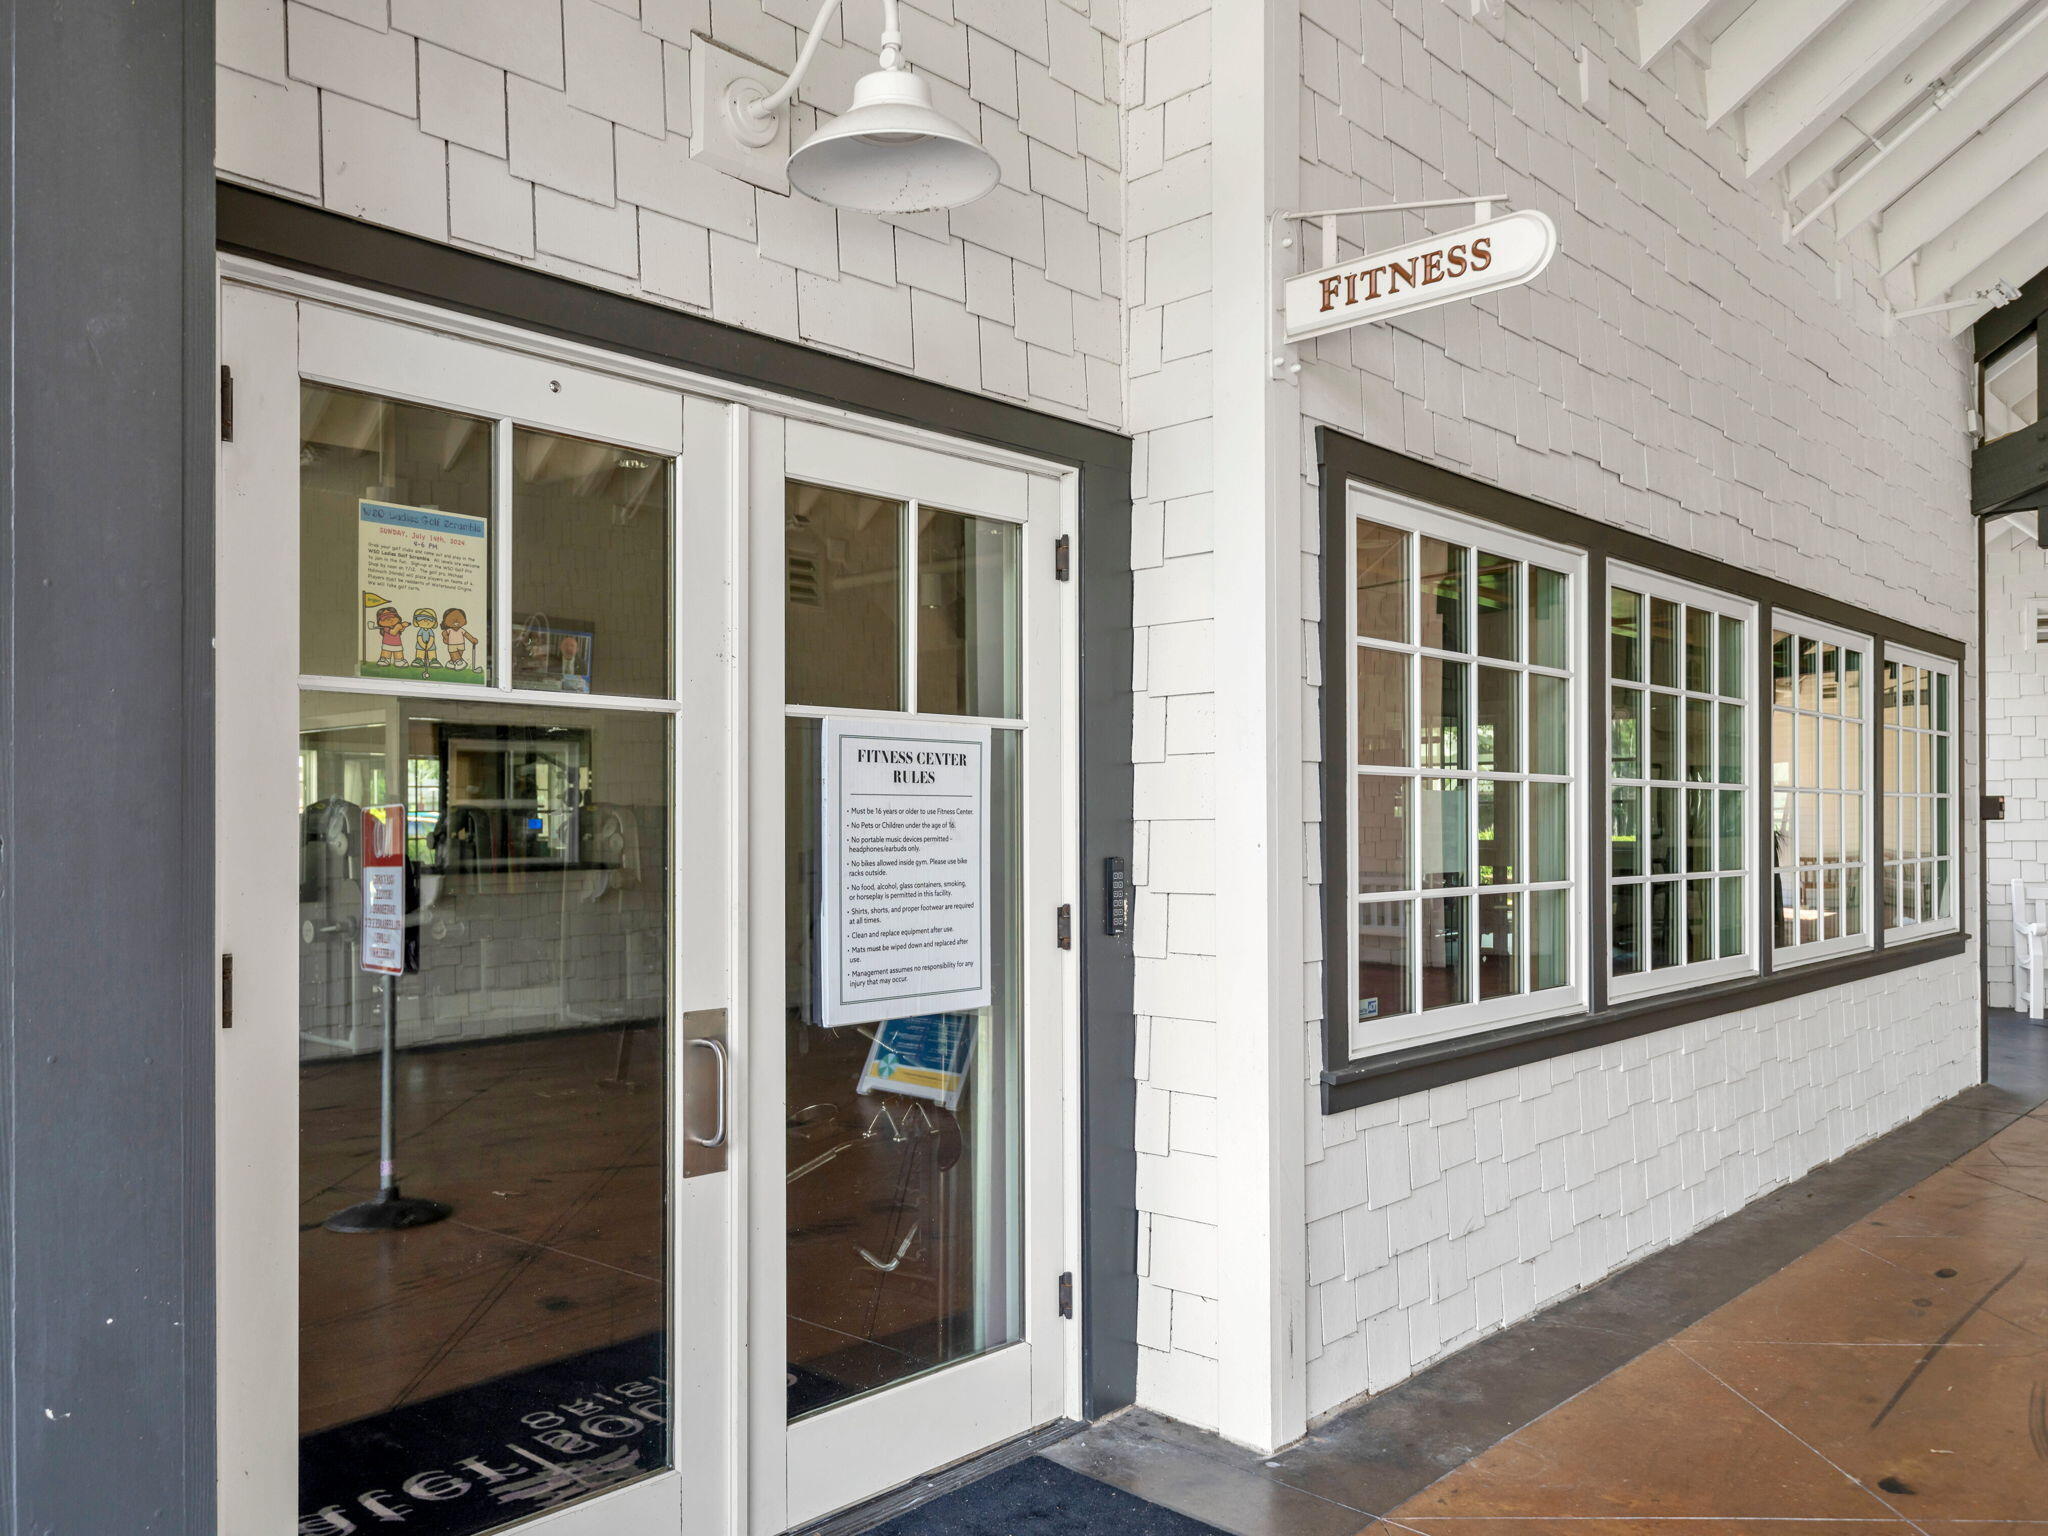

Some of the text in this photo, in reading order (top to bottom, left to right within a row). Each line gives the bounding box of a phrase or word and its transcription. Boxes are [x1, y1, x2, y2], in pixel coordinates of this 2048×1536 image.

[1318, 236, 1493, 313] FITNESS
[412, 532, 425, 540] July
[858, 749, 966, 766] FITNESS CENTER
[893, 770, 935, 783] RULES
[861, 836, 884, 844] portable
[923, 835, 948, 843] permitted
[848, 844, 906, 853] headphones/earbuds
[899, 881, 913, 890] glass
[856, 892, 883, 901] horseplay
[890, 891, 916, 899] permitted
[891, 905, 901, 913] and
[902, 905, 919, 913] proper
[920, 903, 944, 911] footwear
[953, 902, 974, 910] required
[851, 931, 867, 939] Clean
[868, 930, 879, 938] and
[880, 928, 899, 938] replace
[900, 927, 929, 936] equipment
[930, 925, 942, 933] after
[851, 945, 865, 953] Mats
[881, 943, 889, 951] be
[890, 942, 906, 951] wiped
[907, 941, 922, 949] down
[934, 938, 955, 947] replaced
[851, 967, 888, 979] Management
[889, 966, 913, 975] assumes
[921, 961, 956, 972] responsibility
[849, 979, 865, 988] injury
[866, 977, 878, 985] that
[879, 977, 891, 985] may
